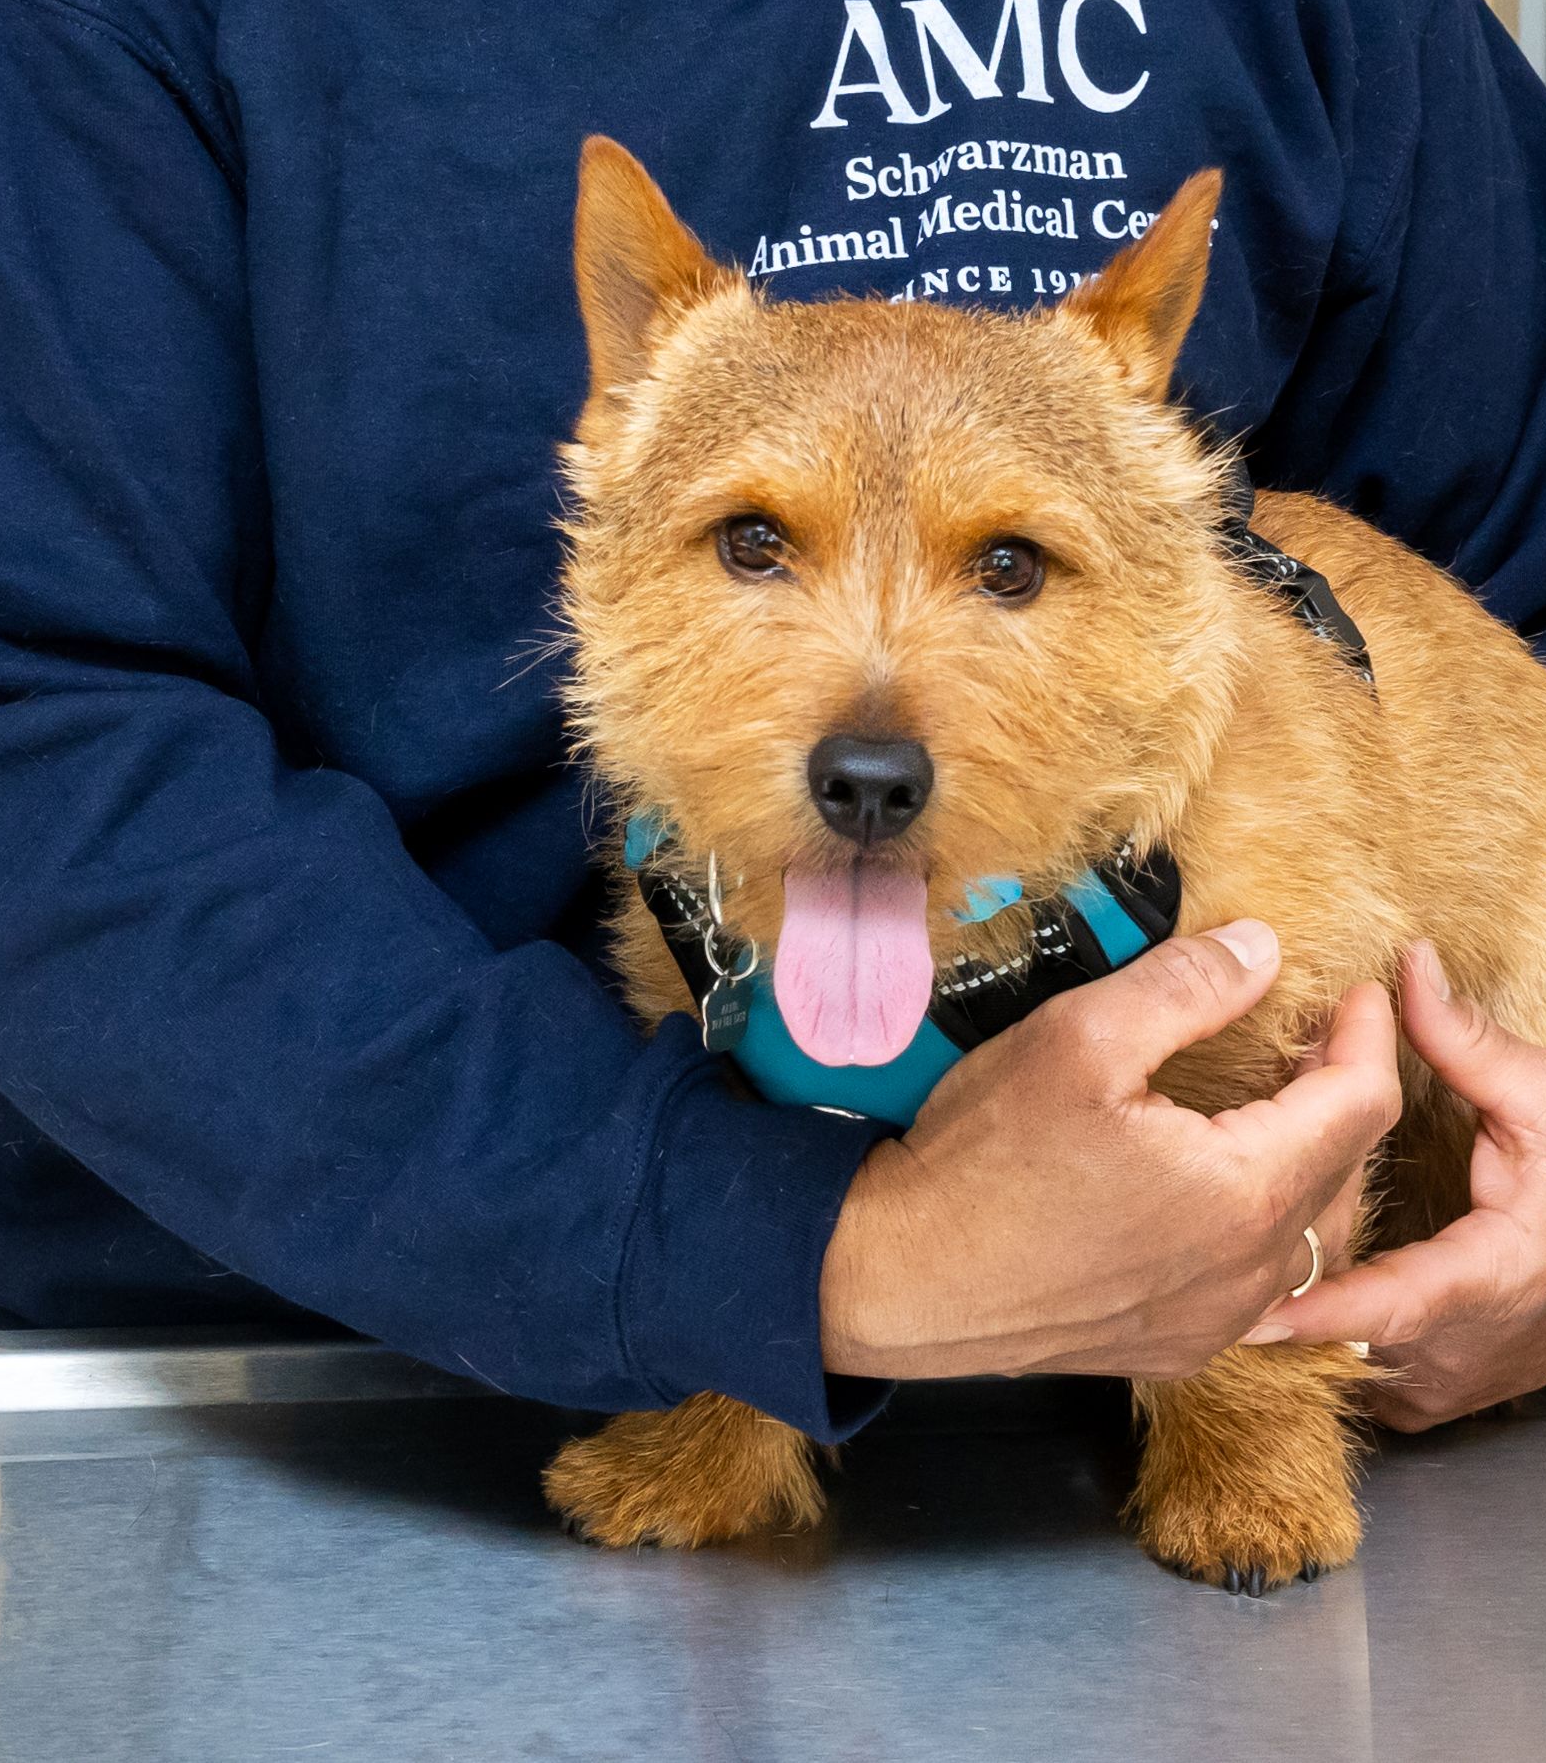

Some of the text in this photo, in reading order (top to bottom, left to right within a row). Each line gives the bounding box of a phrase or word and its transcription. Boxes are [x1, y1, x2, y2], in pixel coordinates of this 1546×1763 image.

[845, 139, 1127, 202] Schwarzman
[747, 217, 909, 278] Animal
[916, 190, 1079, 249] Medical
